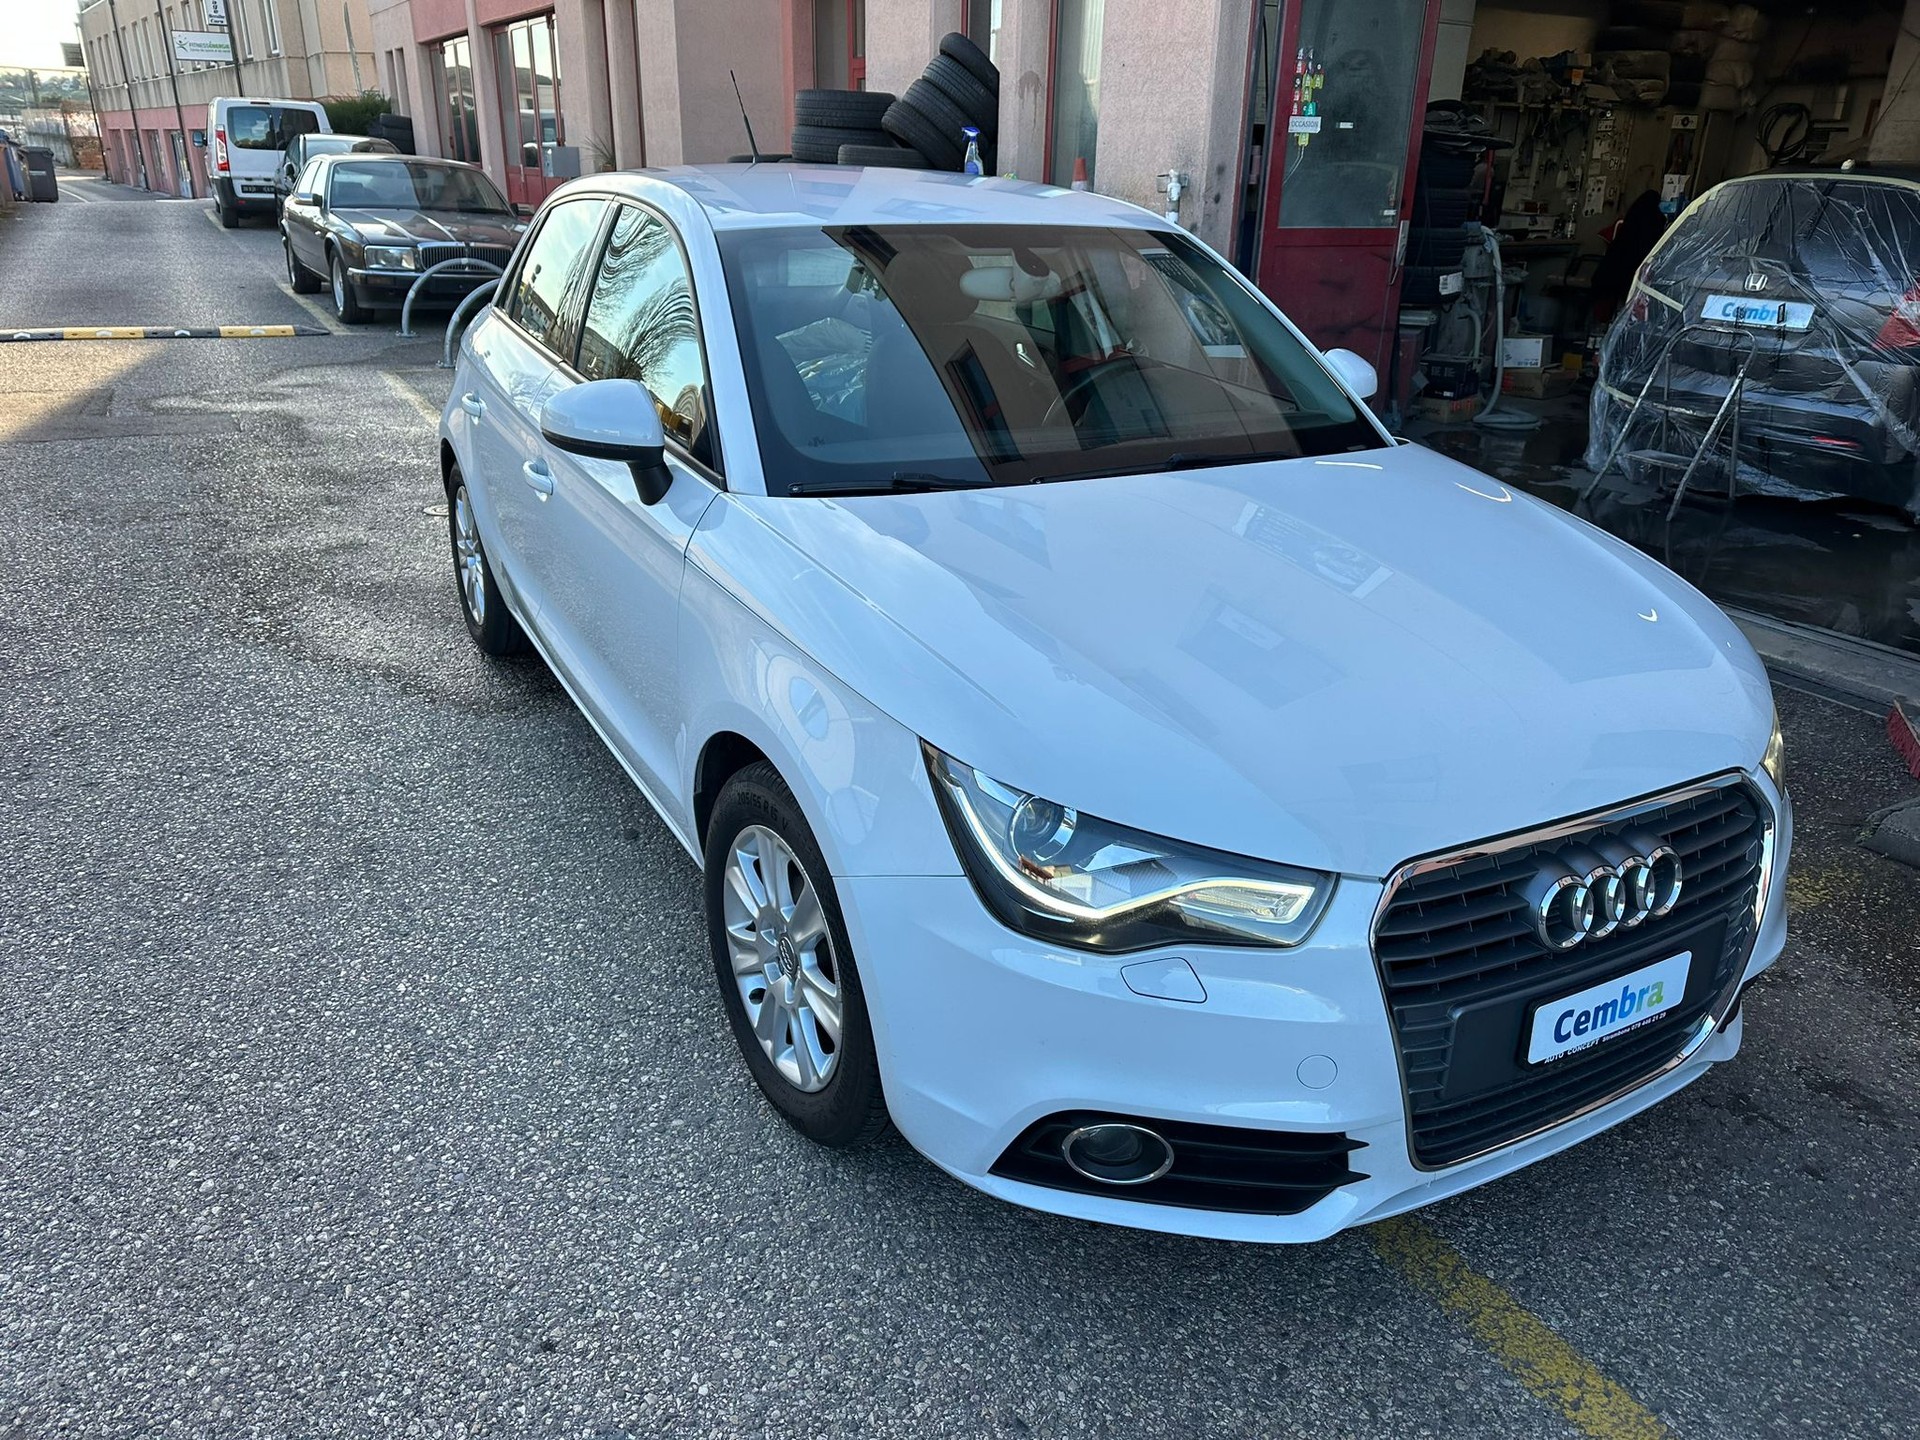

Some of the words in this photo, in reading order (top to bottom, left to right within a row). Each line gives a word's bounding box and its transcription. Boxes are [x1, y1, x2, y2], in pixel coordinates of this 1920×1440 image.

[1721, 302, 1787, 321] Cmbr
[1554, 981, 1664, 1043] Cembra
[1544, 1051, 1564, 1064] AUTO
[1567, 1038, 1600, 1056] CONCEPT
